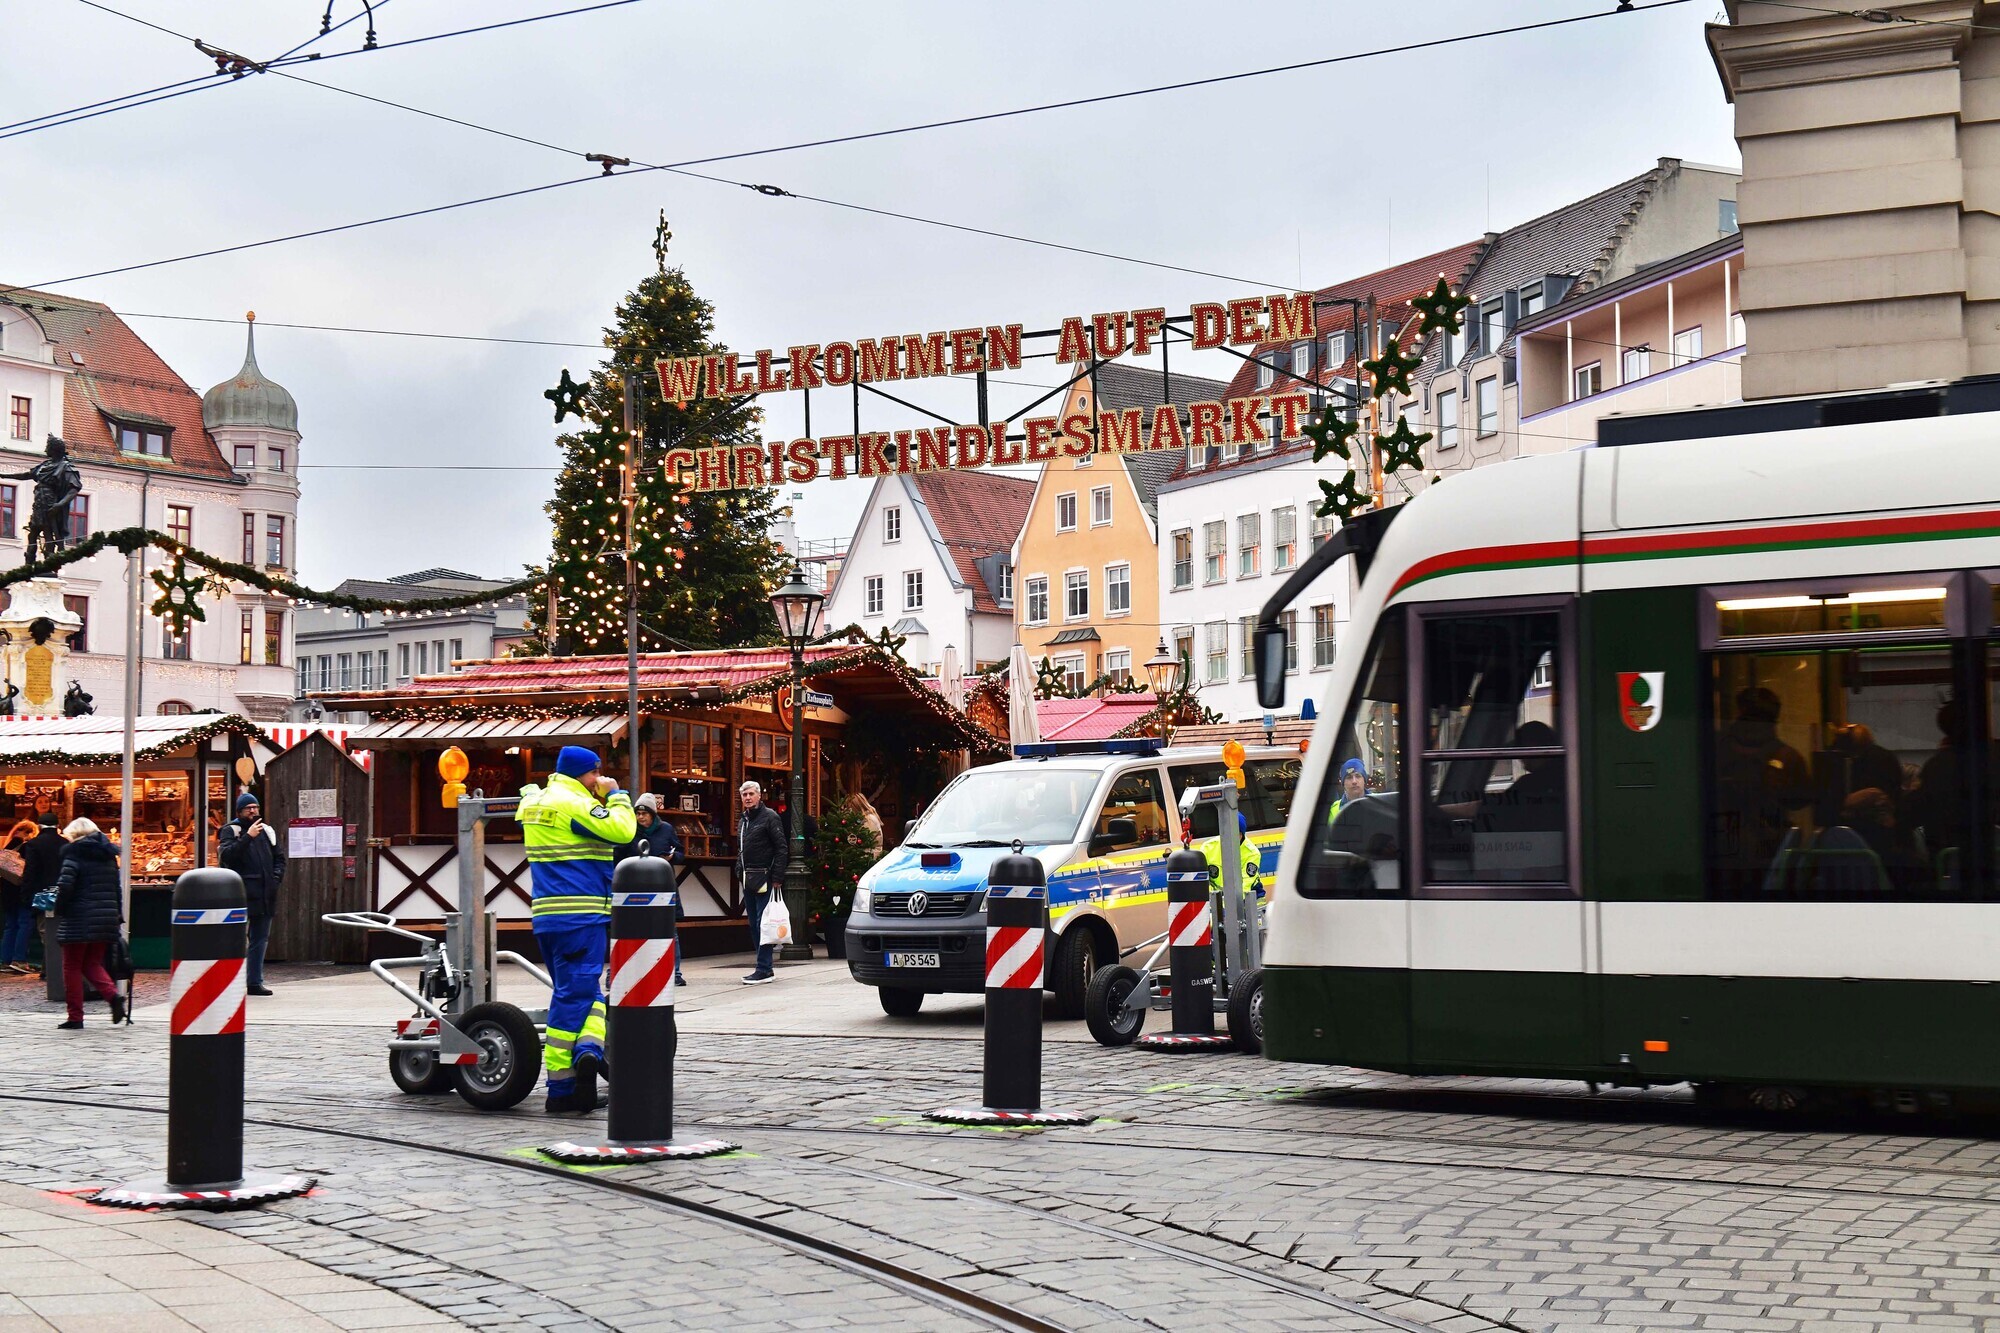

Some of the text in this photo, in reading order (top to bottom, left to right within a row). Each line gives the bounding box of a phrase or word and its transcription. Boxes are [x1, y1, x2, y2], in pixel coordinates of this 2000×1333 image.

[654, 292, 1316, 402] WILLKOMMEN AUF DEM
[664, 392, 1311, 493] CHRISTKINDLESMARKT
[896, 869, 961, 881] POLIZEI
[917, 954, 936, 966] 545
